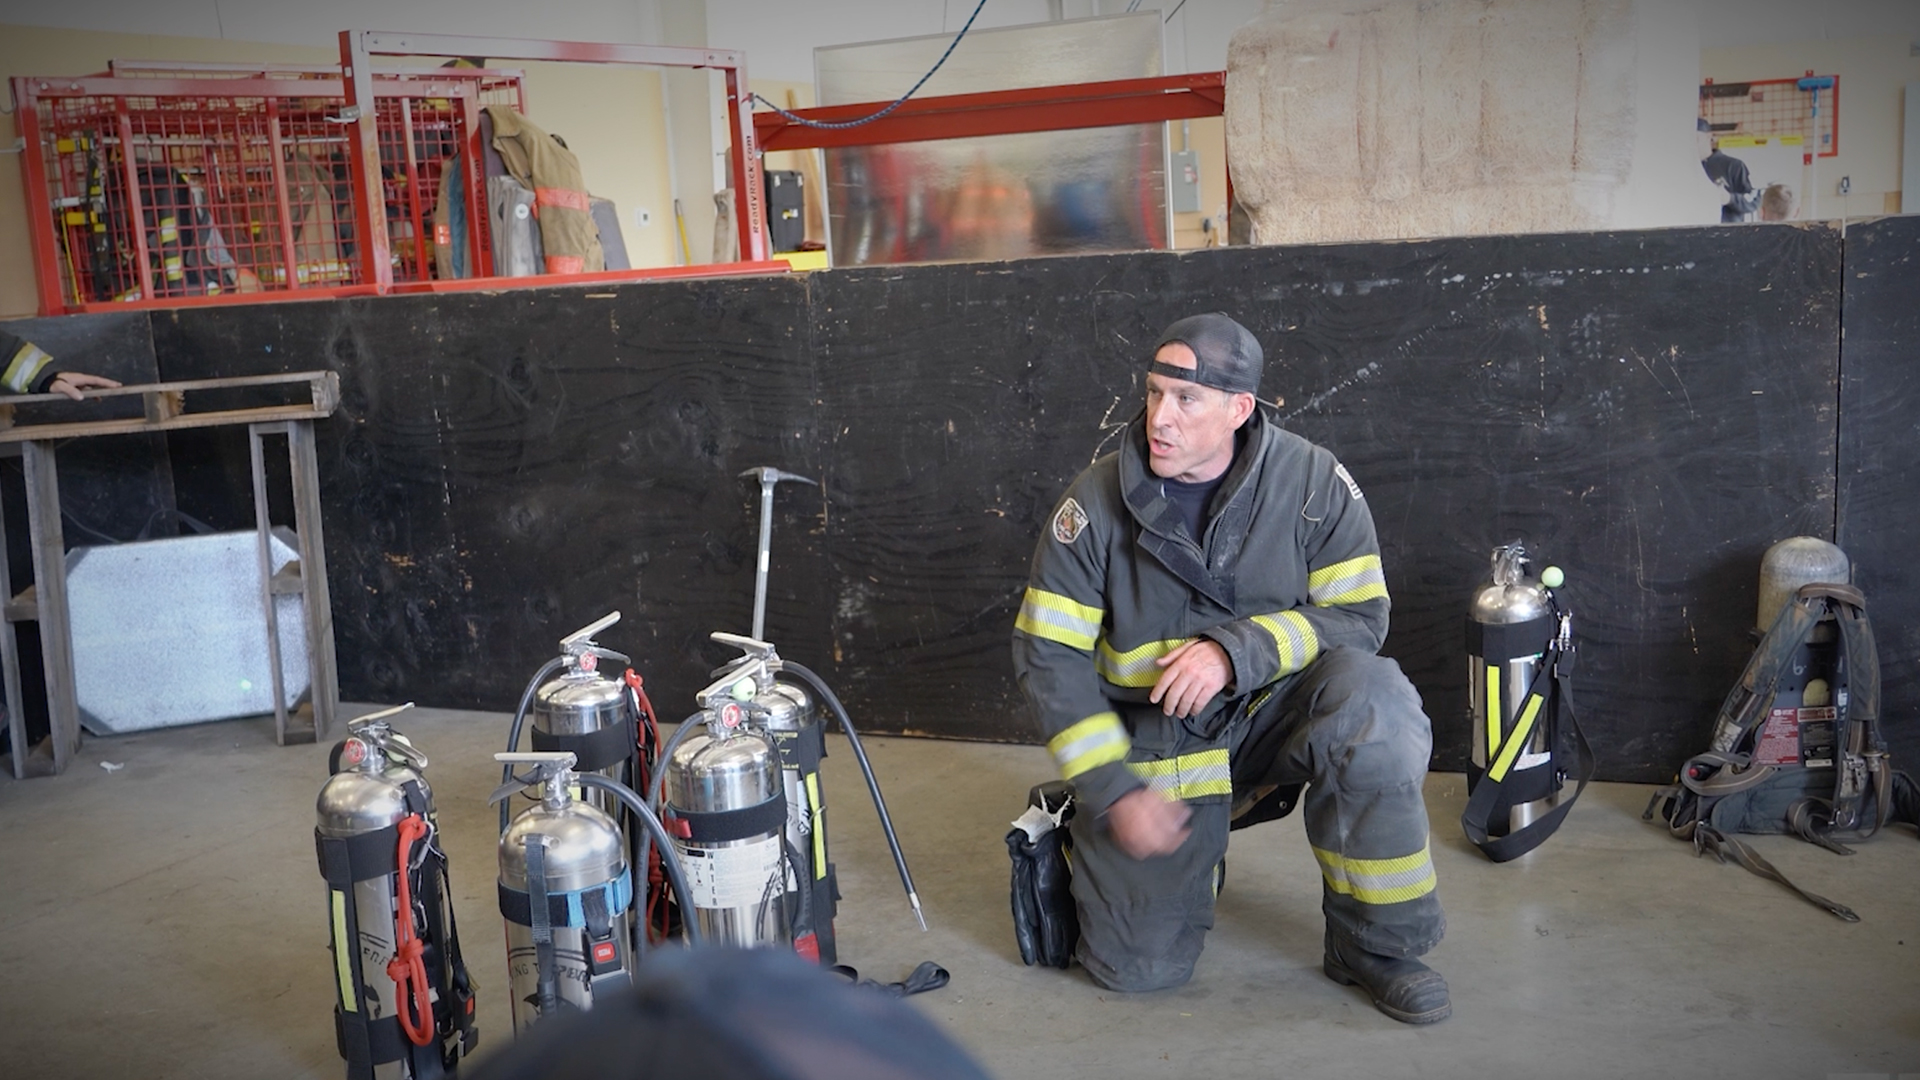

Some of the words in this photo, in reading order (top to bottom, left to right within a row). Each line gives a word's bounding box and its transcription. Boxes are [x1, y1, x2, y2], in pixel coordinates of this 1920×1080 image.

[475, 159, 488, 251] ReadyRack.com
[746, 135, 759, 233] ReadyRack.com
[706, 851, 718, 906] WATER
